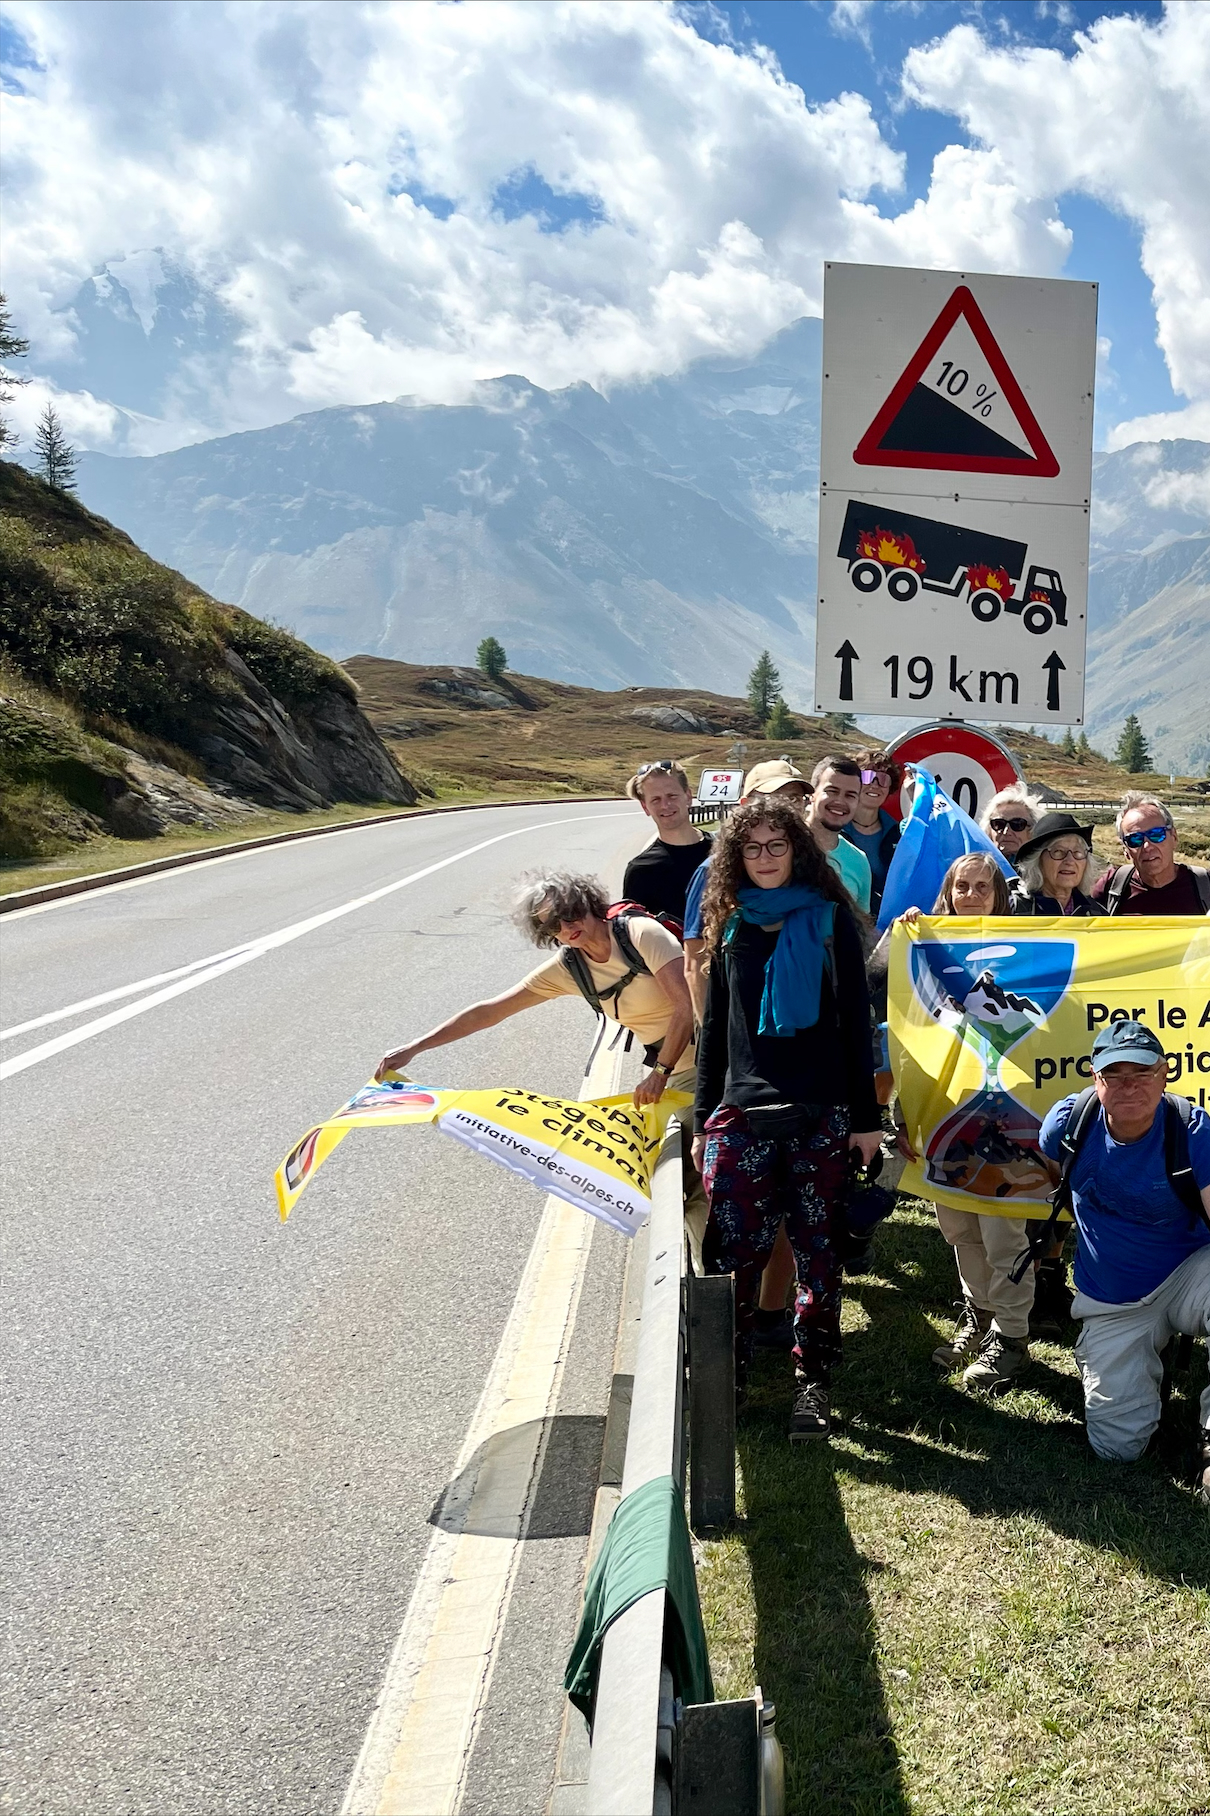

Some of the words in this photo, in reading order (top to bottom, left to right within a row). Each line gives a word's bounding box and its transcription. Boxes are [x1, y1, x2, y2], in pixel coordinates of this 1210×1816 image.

[883, 654, 934, 700] 19
[949, 654, 1019, 705] km
[709, 785, 728, 796] 24
[1086, 1003, 1146, 1031] Per
[1158, 999, 1187, 1029] le
[455, 1113, 635, 1215] initiative-des-alpes.ch
[495, 1098, 529, 1116] le
[542, 1118, 647, 1190] climat
